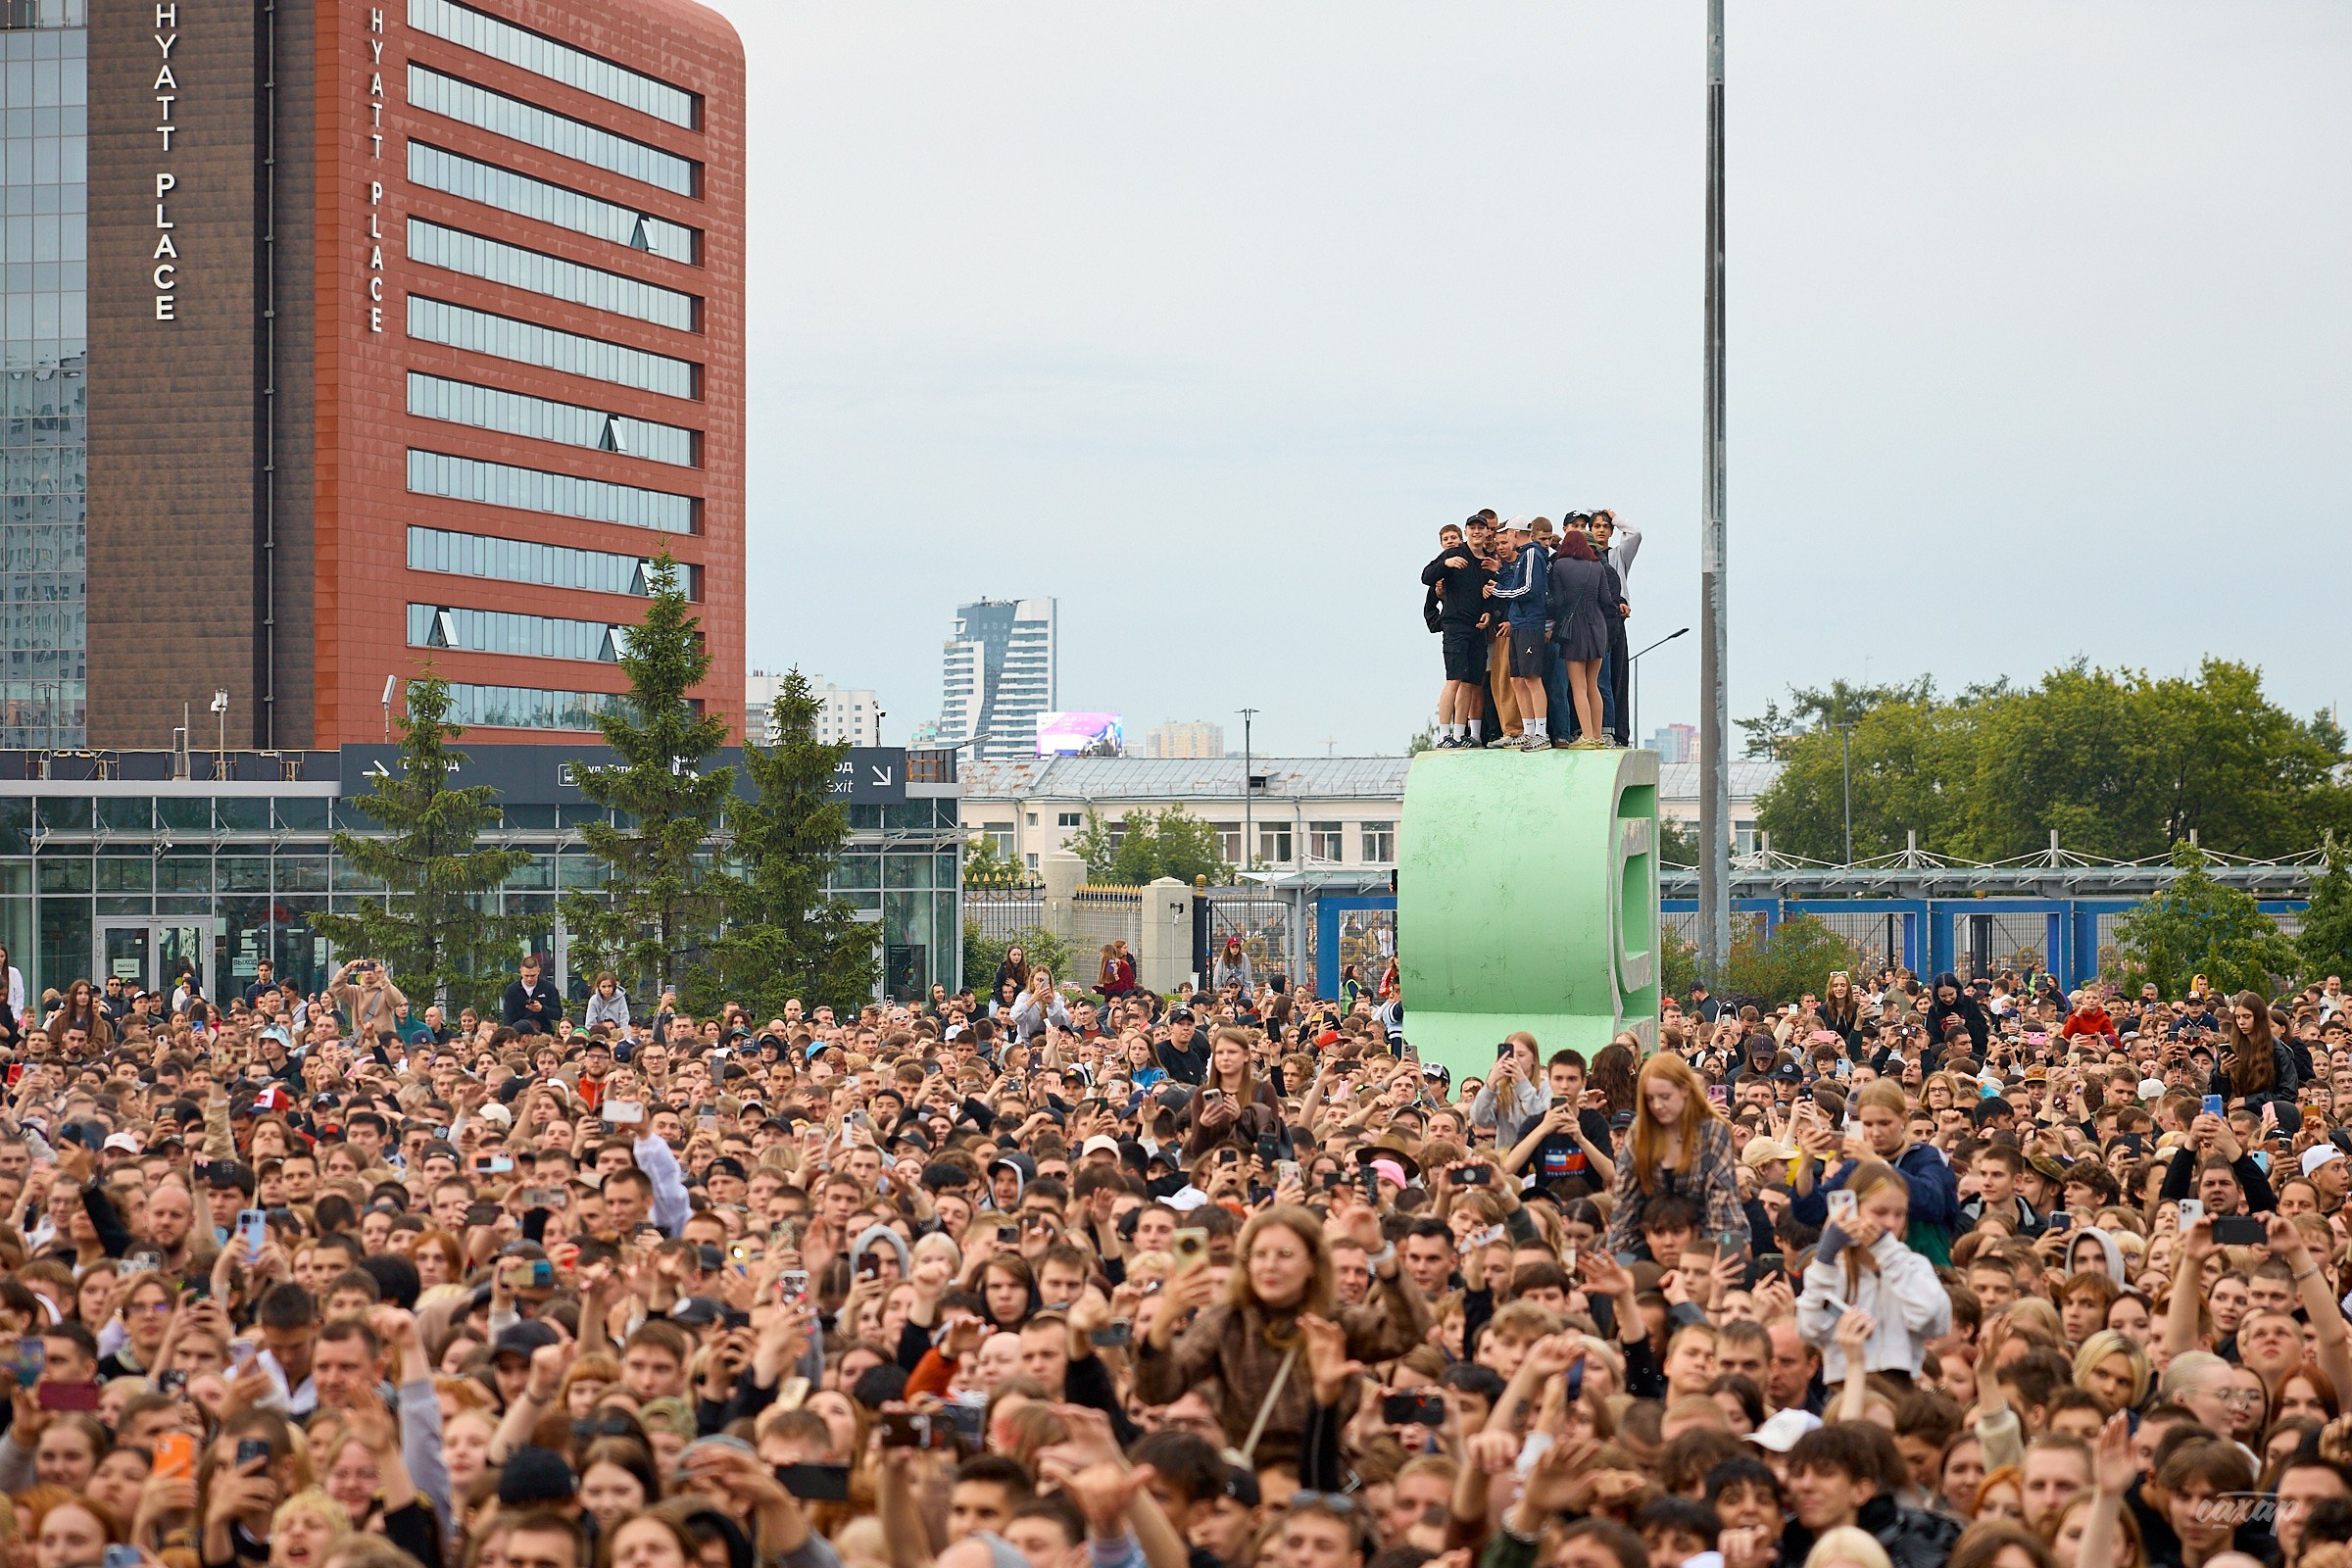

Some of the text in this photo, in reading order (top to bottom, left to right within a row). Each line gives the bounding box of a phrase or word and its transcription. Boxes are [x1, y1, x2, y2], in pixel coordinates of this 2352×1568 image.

[153, 3, 177, 321] HYATT PLACE
[368, 7, 384, 334] HYATT PLACE
